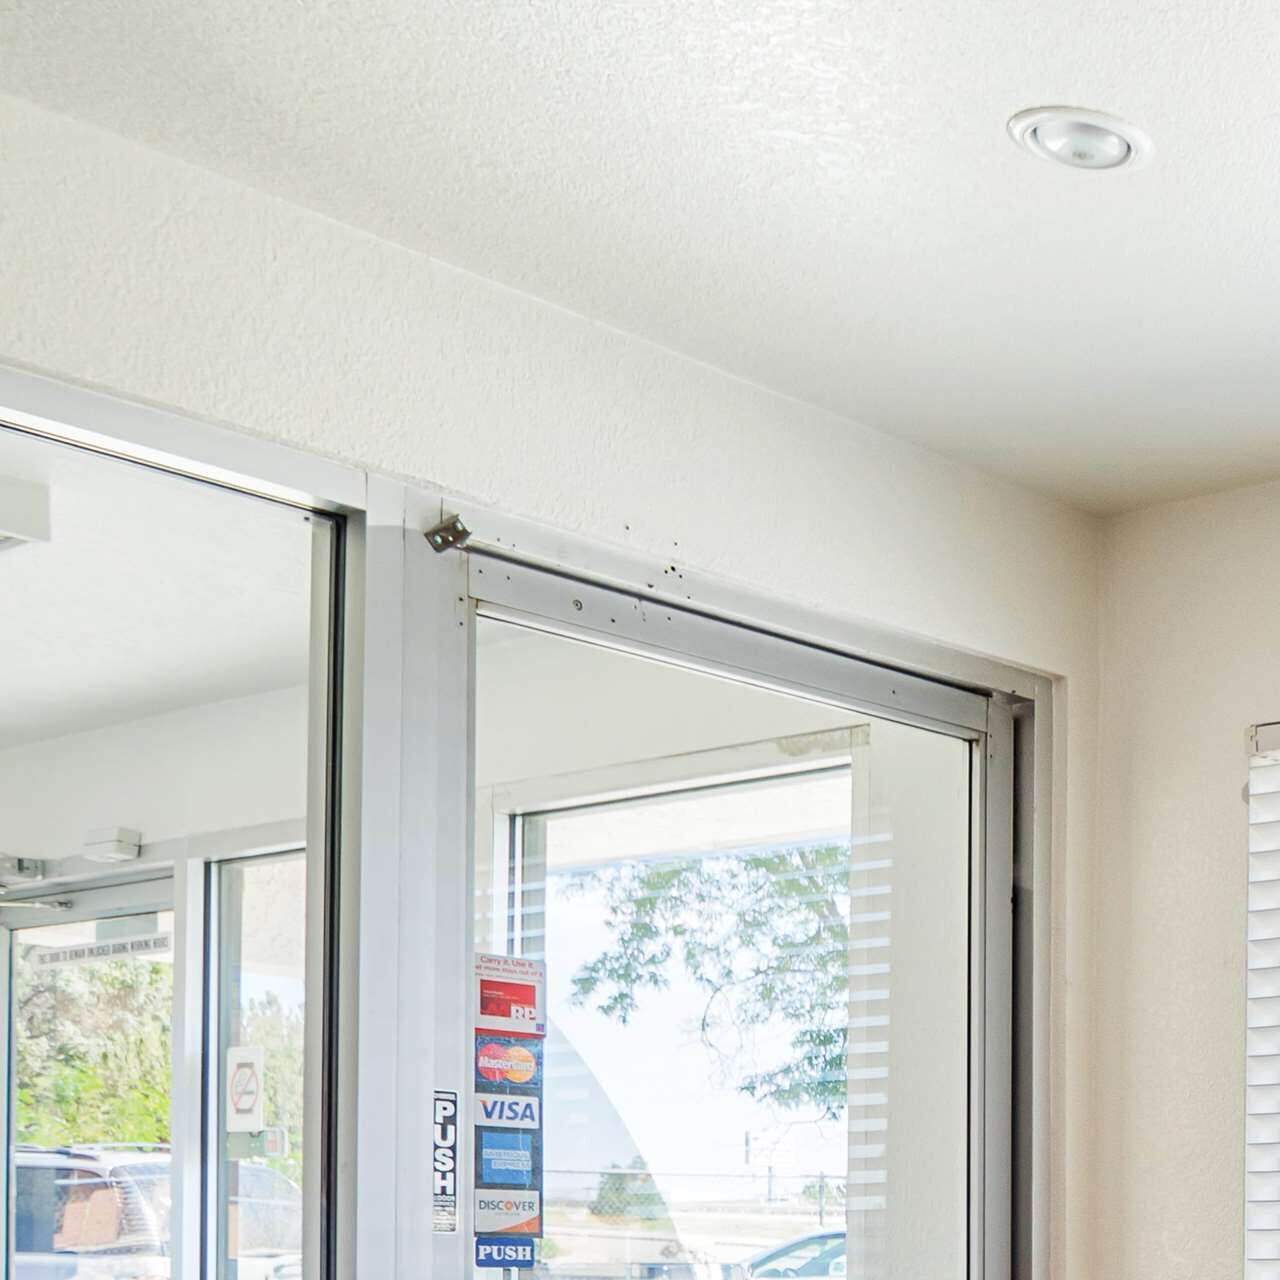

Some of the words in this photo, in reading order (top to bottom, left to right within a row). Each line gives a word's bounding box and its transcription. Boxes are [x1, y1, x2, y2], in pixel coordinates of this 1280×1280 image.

[480, 1100, 535, 1121] VISA
[434, 1099, 456, 1195] PUSH
[479, 1200, 535, 1212] DISCOVER
[478, 1245, 532, 1261] PUSH
